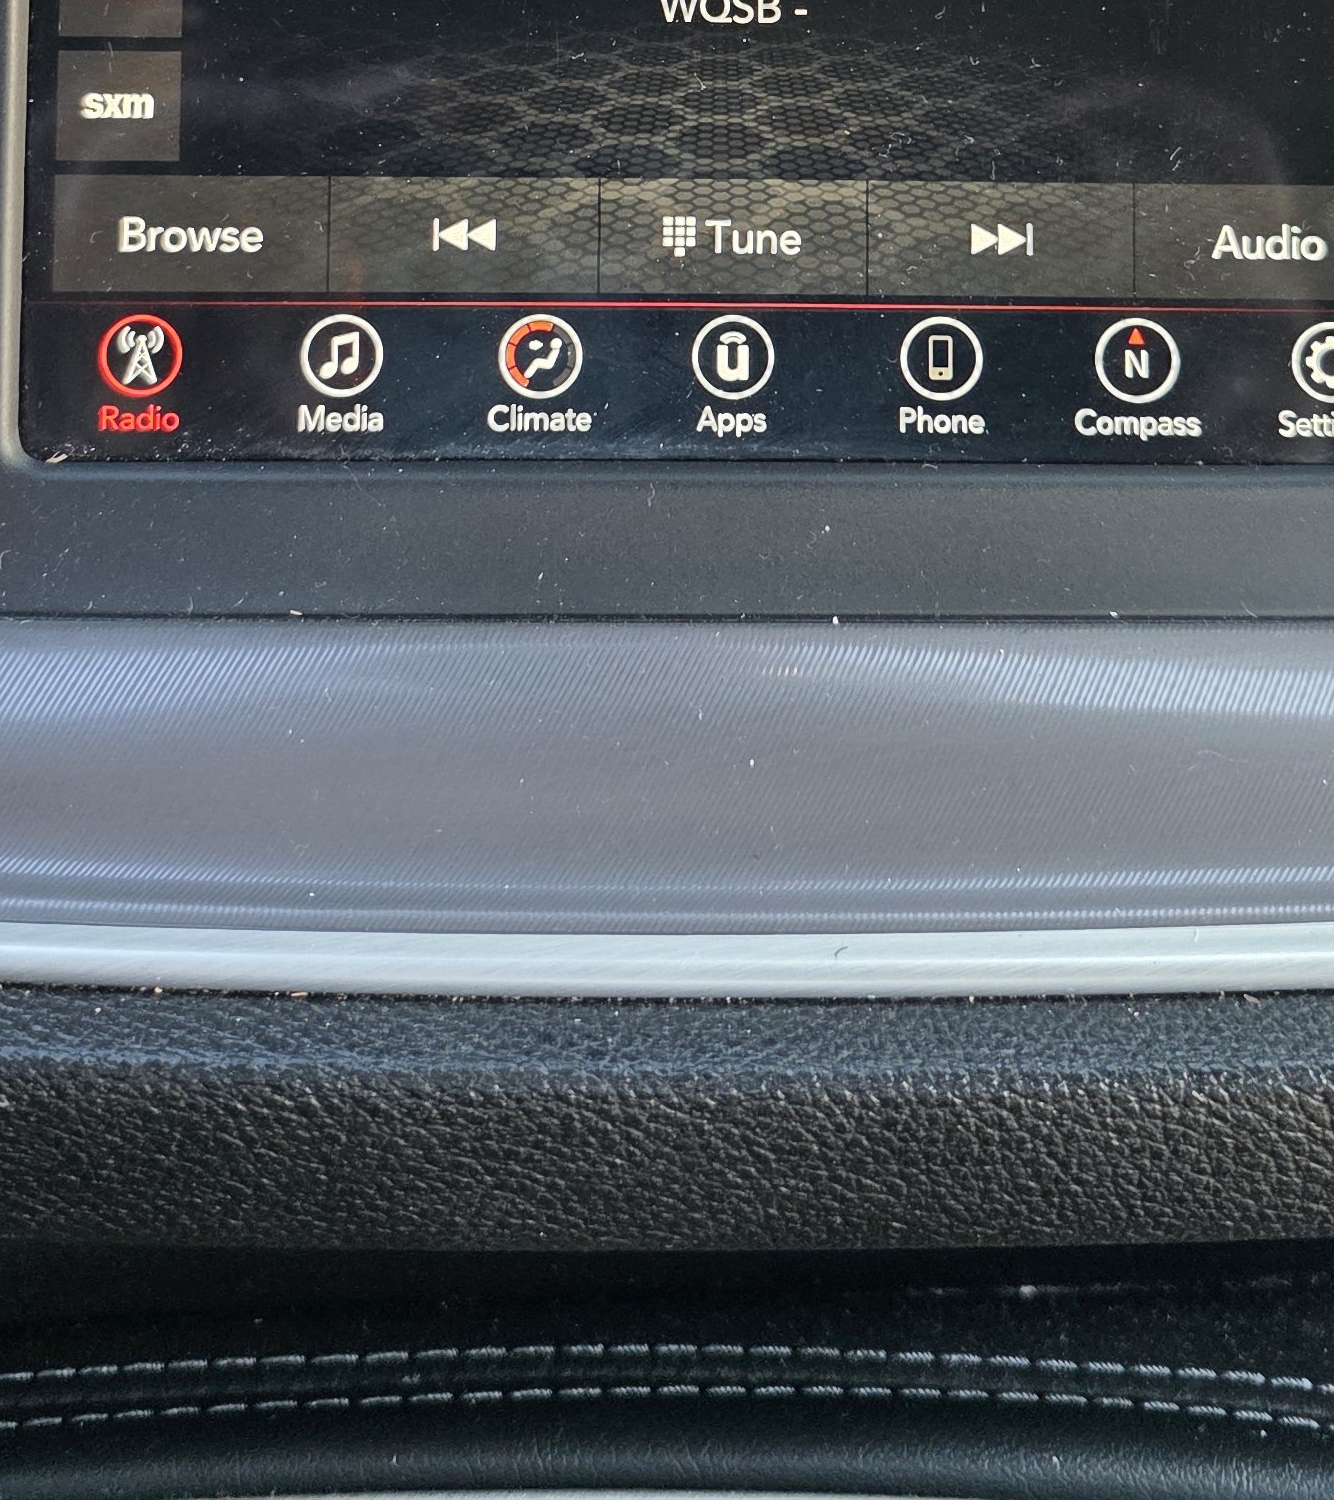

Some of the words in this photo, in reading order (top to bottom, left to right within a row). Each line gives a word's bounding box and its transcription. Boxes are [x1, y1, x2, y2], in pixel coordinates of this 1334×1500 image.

[80, 92, 155, 120] sxm
[118, 215, 264, 253] Browse
[706, 219, 802, 256] Tune
[1210, 223, 1328, 261] Audio
[97, 403, 180, 433] Radio
[297, 403, 384, 433] Media
[486, 403, 593, 433] Climate
[695, 405, 768, 438] Apps
[899, 405, 986, 435] Phone
[1074, 407, 1203, 442] Compass
